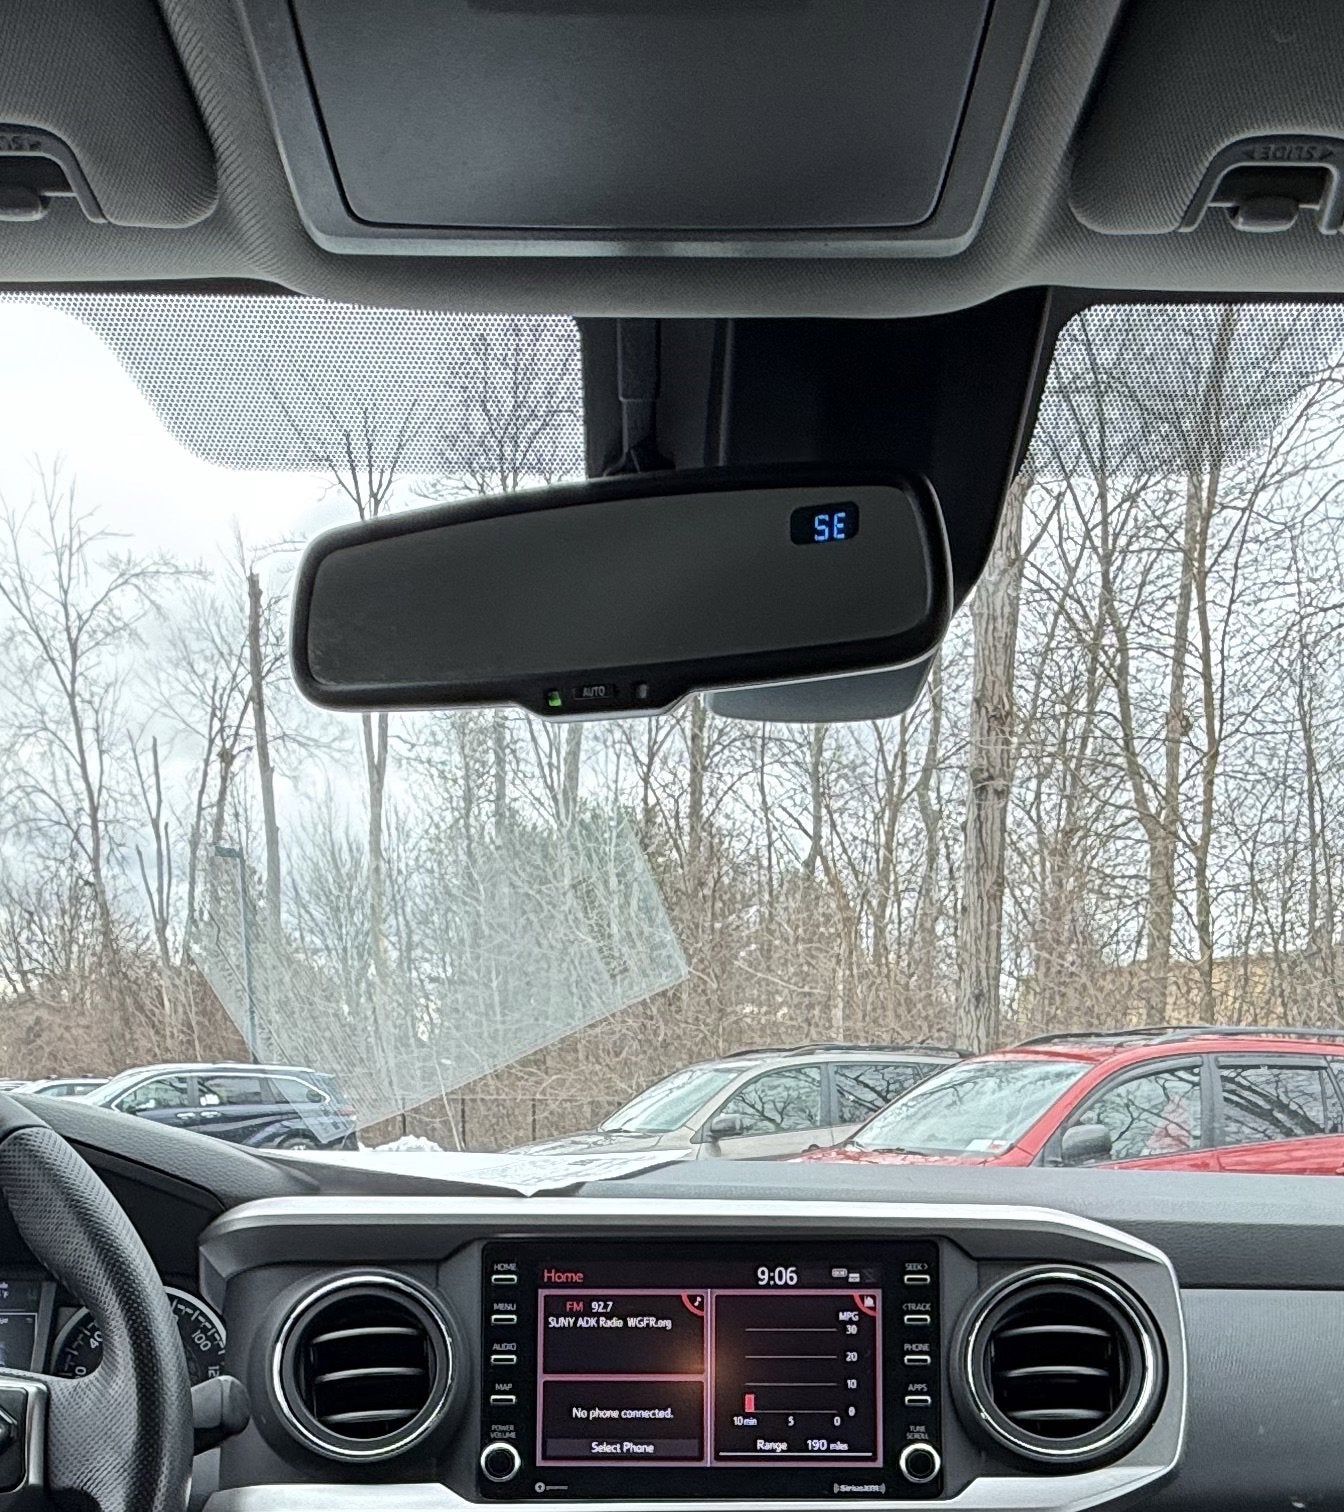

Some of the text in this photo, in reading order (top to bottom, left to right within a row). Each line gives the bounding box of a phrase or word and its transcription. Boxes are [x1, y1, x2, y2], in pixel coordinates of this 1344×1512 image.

[1261, 144, 1319, 162] SLIDE
[814, 512, 846, 541] SE
[583, 686, 606, 697] AUTO
[494, 1263, 517, 1271] HOME
[543, 1269, 584, 1283] Home
[757, 1266, 798, 1285] 9:06
[494, 1303, 517, 1311] MENU
[566, 1301, 614, 1313] FM 92.7
[839, 1311, 859, 1322] MPG
[548, 1317, 672, 1330] SUNY ADK Radio WGFR.org
[845, 1324, 857, 1335] 30
[191, 1329, 211, 1351] 100
[493, 1343, 517, 1351] AUDIO
[904, 1343, 930, 1352] PHONE
[845, 1352, 857, 1362] 20
[495, 1383, 512, 1391] MAP
[847, 1379, 857, 1389] 10
[908, 1384, 928, 1392] APPS
[572, 1407, 674, 1420] No phone connected.
[848, 1406, 856, 1416] 0
[788, 1416, 795, 1426] 5
[833, 1416, 841, 1427] 0
[591, 1441, 654, 1453] Select Phone
[756, 1440, 788, 1452] Range
[806, 1440, 827, 1450] 190
